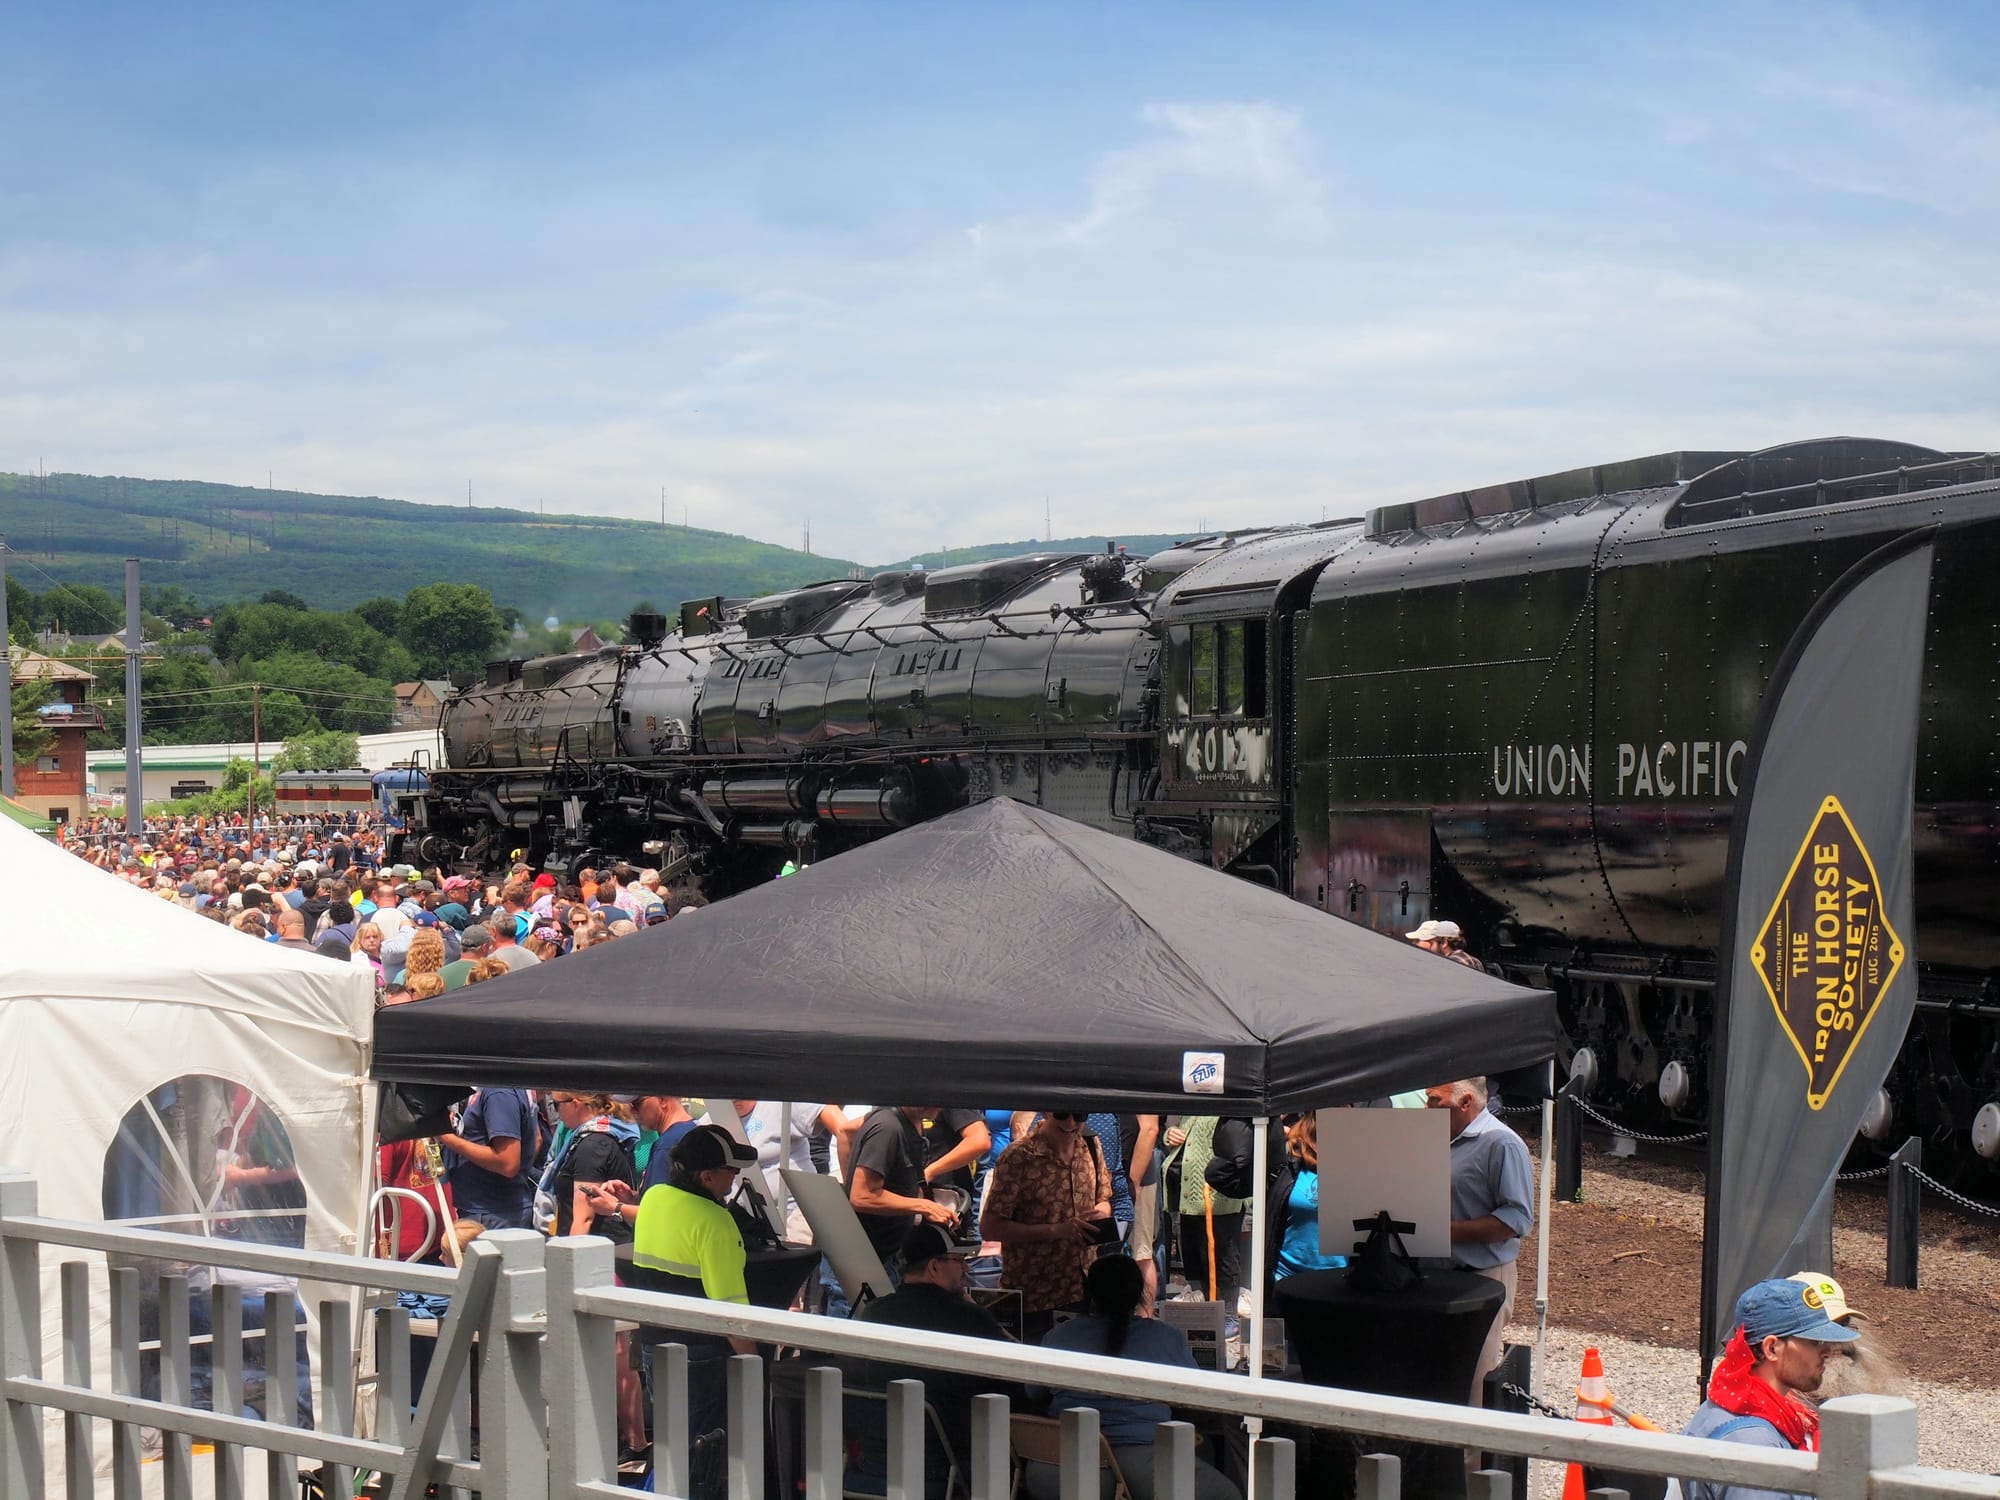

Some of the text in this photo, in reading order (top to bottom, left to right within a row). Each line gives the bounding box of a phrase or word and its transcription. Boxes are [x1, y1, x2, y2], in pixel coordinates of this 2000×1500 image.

[1493, 740, 1747, 798] UNION PACIFIC
[1792, 931, 1809, 978] THE
[1814, 843, 1840, 1064] IRON HORSE
[1833, 875, 1870, 1032] SOCIETY
